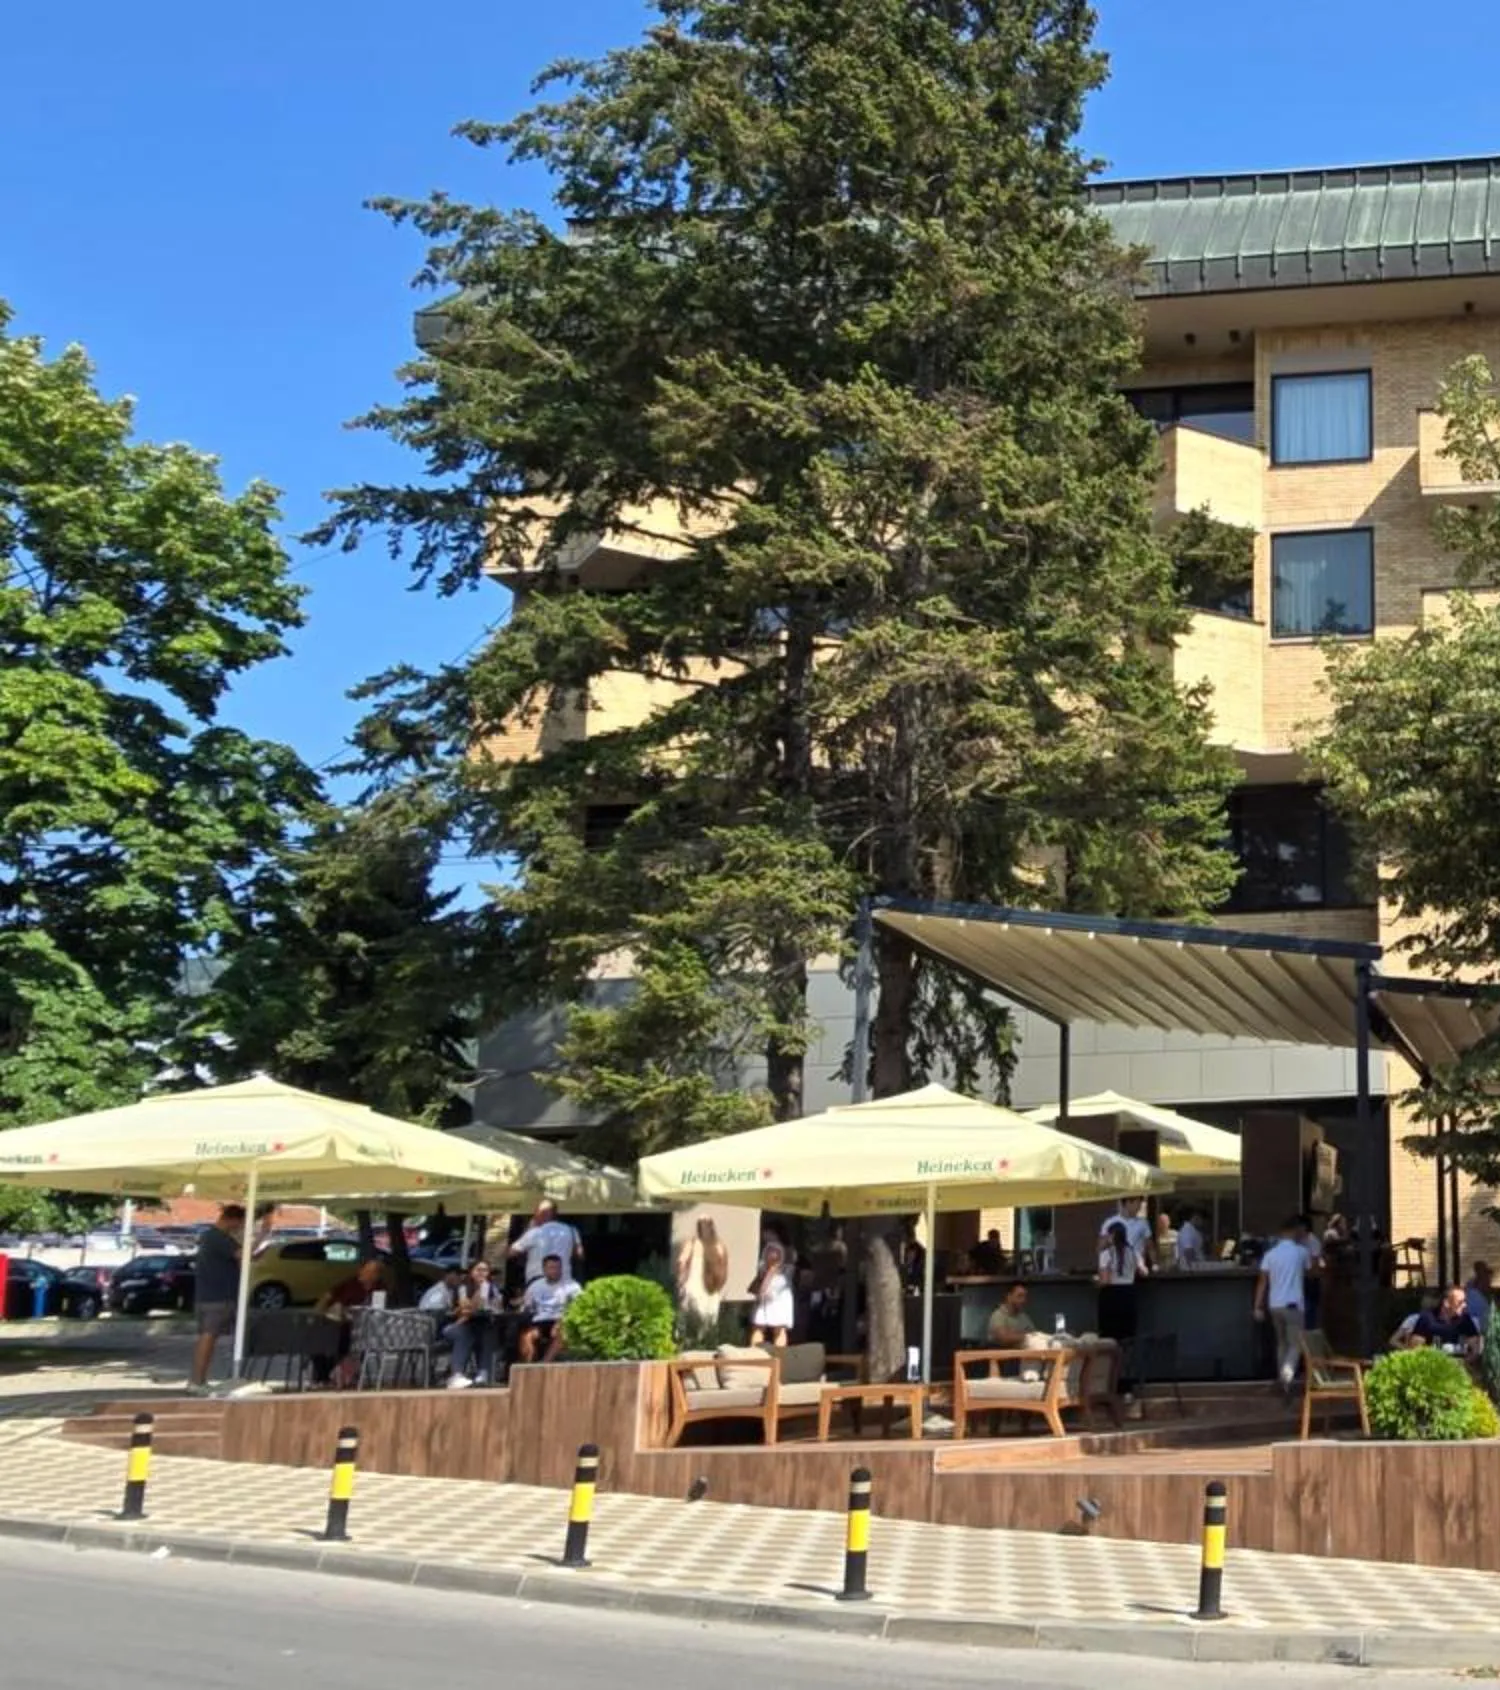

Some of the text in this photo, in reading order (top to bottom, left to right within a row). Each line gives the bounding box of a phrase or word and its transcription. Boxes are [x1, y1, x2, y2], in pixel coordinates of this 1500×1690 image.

[195, 1140, 267, 1156] Heineken
[917, 1158, 994, 1174] Heineken
[680, 1167, 757, 1185] Heineken
